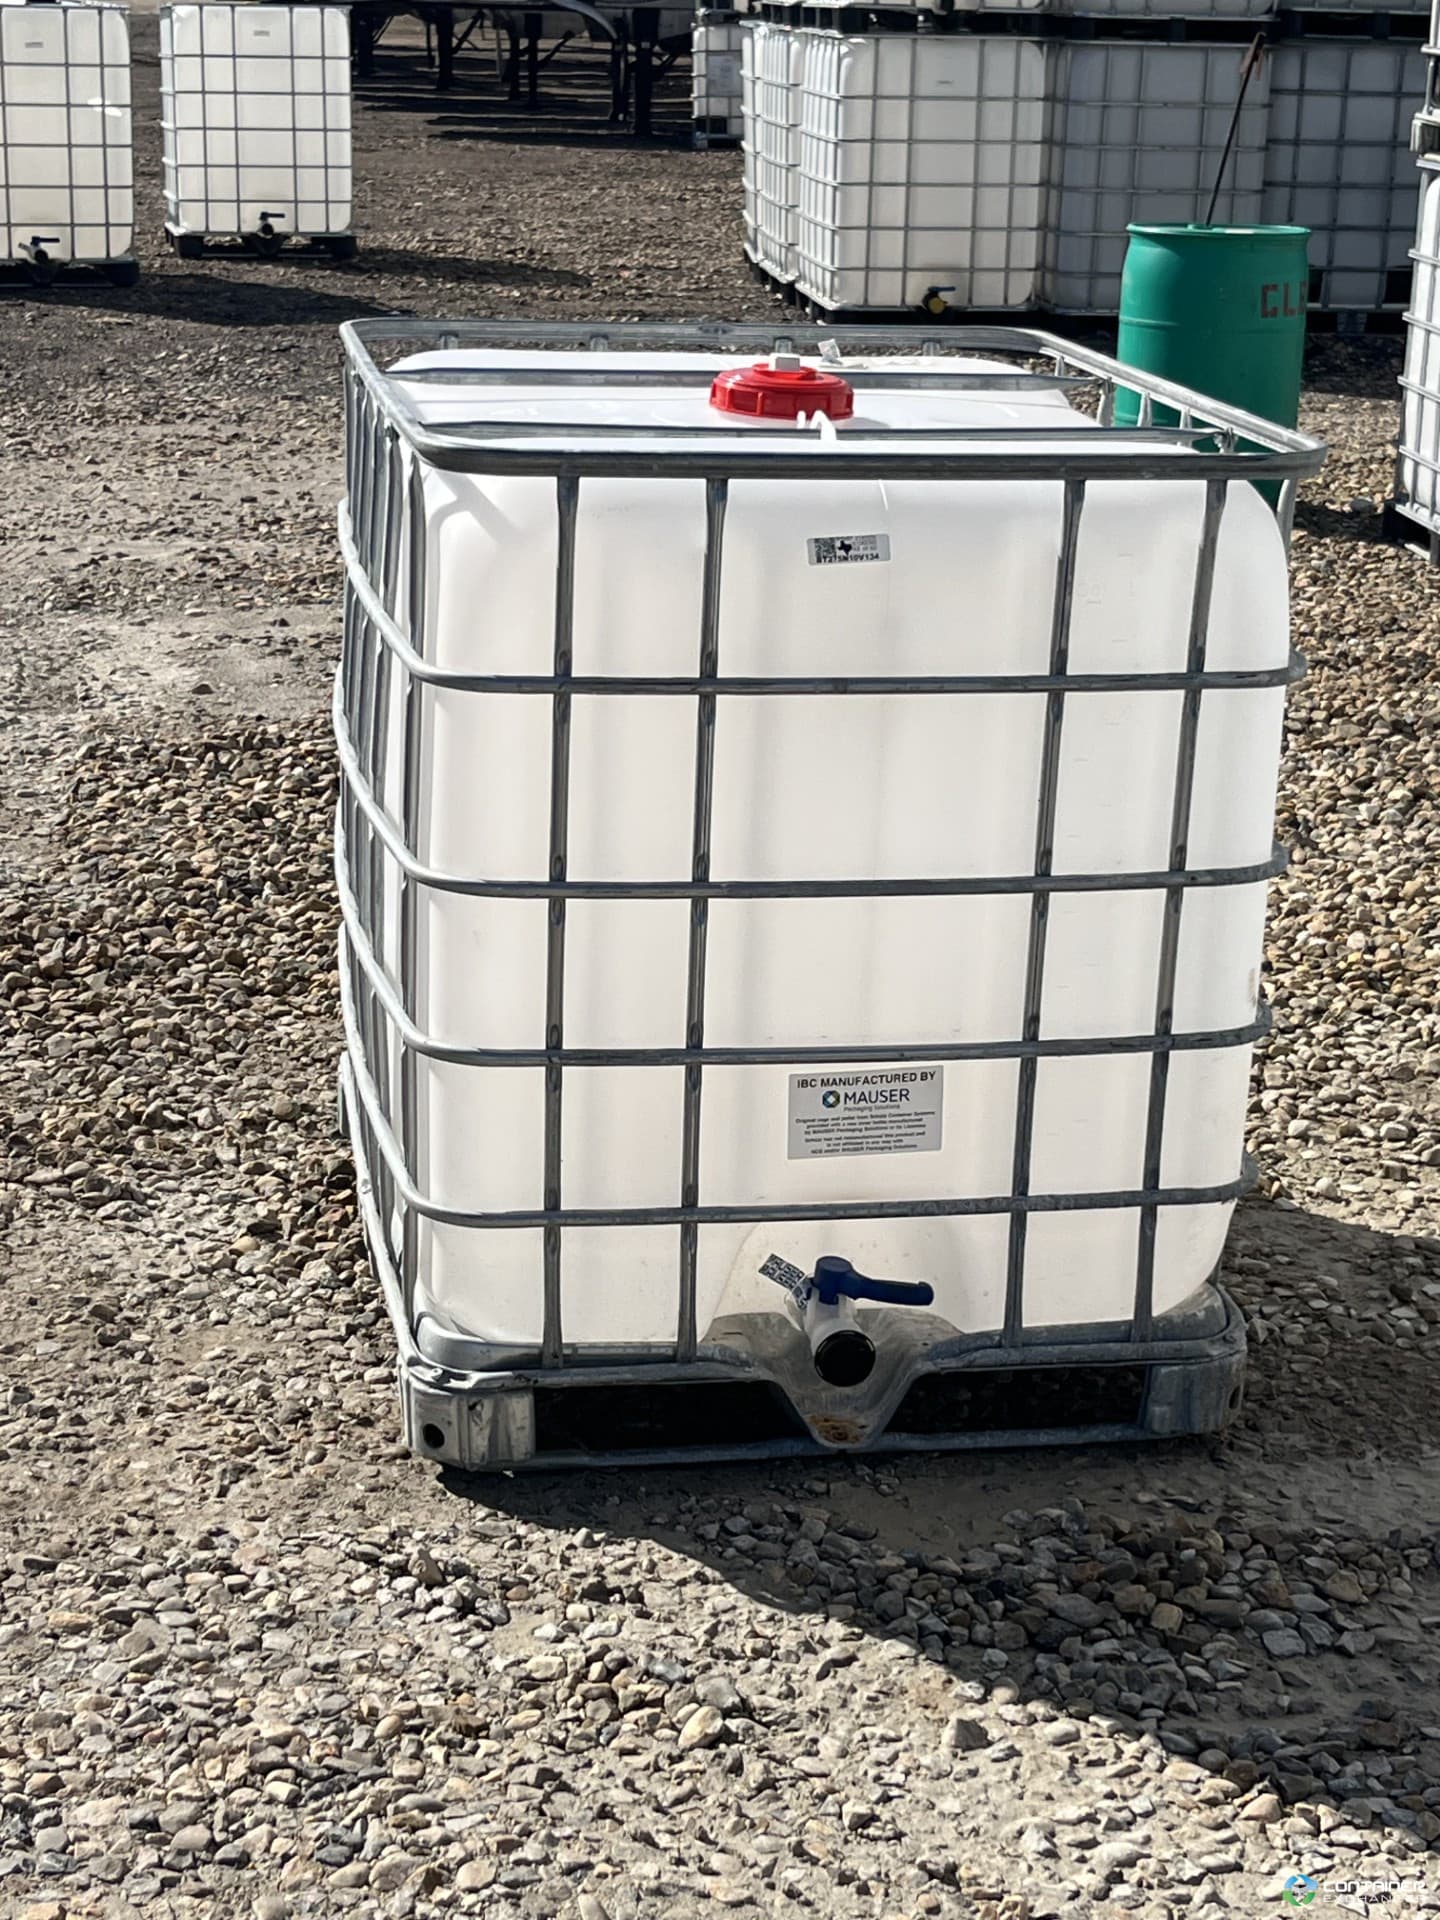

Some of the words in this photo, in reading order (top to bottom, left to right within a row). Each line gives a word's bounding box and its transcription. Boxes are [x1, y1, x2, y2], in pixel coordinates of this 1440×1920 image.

[797, 1078, 818, 1089] IBC
[820, 1072, 918, 1088] MANUFACTURED
[920, 1071, 937, 1082] BY
[843, 1088, 911, 1105] MAUSER
